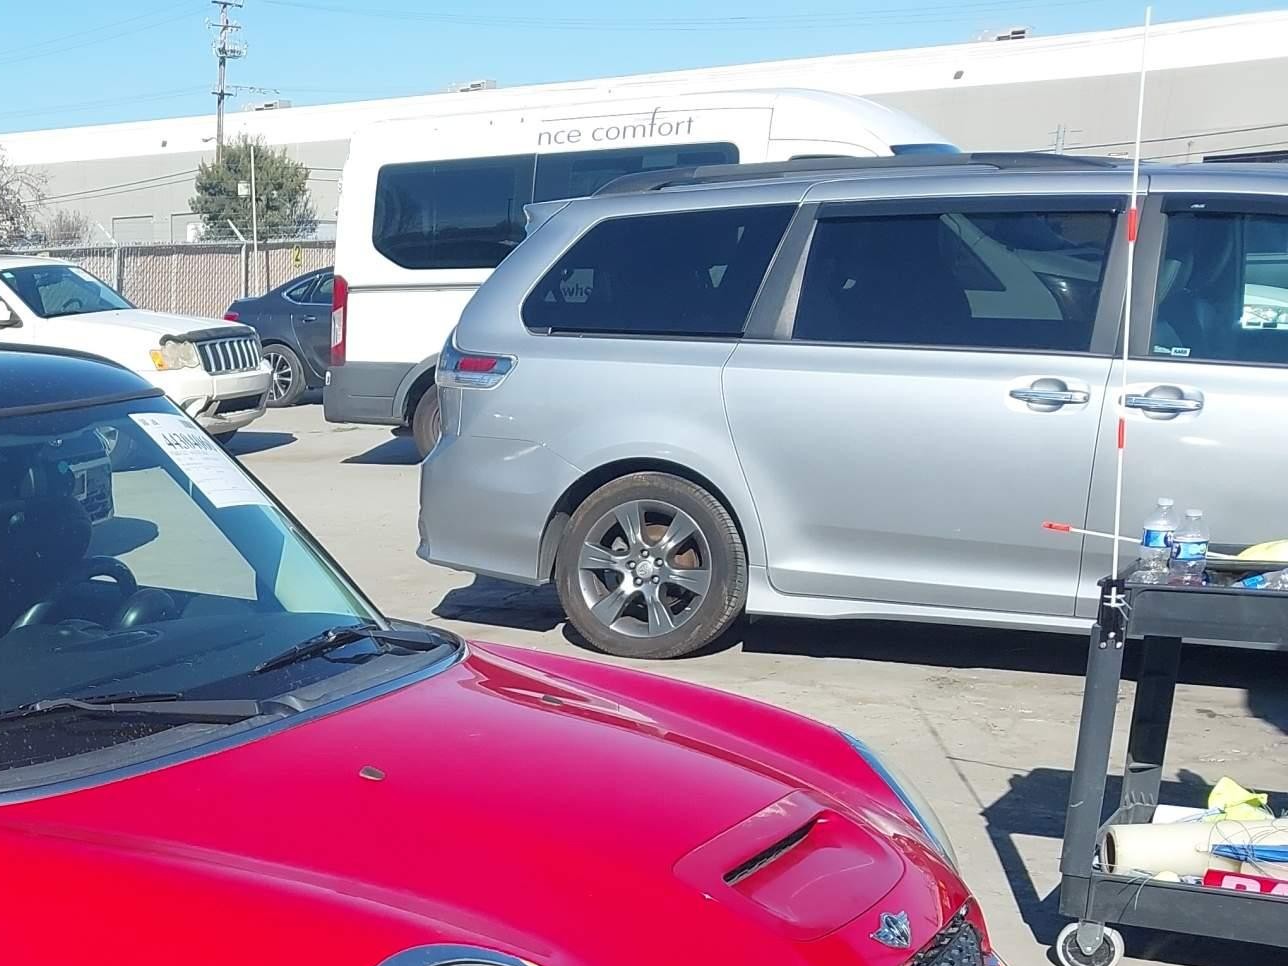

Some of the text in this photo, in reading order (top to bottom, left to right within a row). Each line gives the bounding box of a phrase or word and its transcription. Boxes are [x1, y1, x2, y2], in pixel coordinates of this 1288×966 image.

[537, 106, 694, 146] nce comfort
[294, 245, 301, 262] 2
